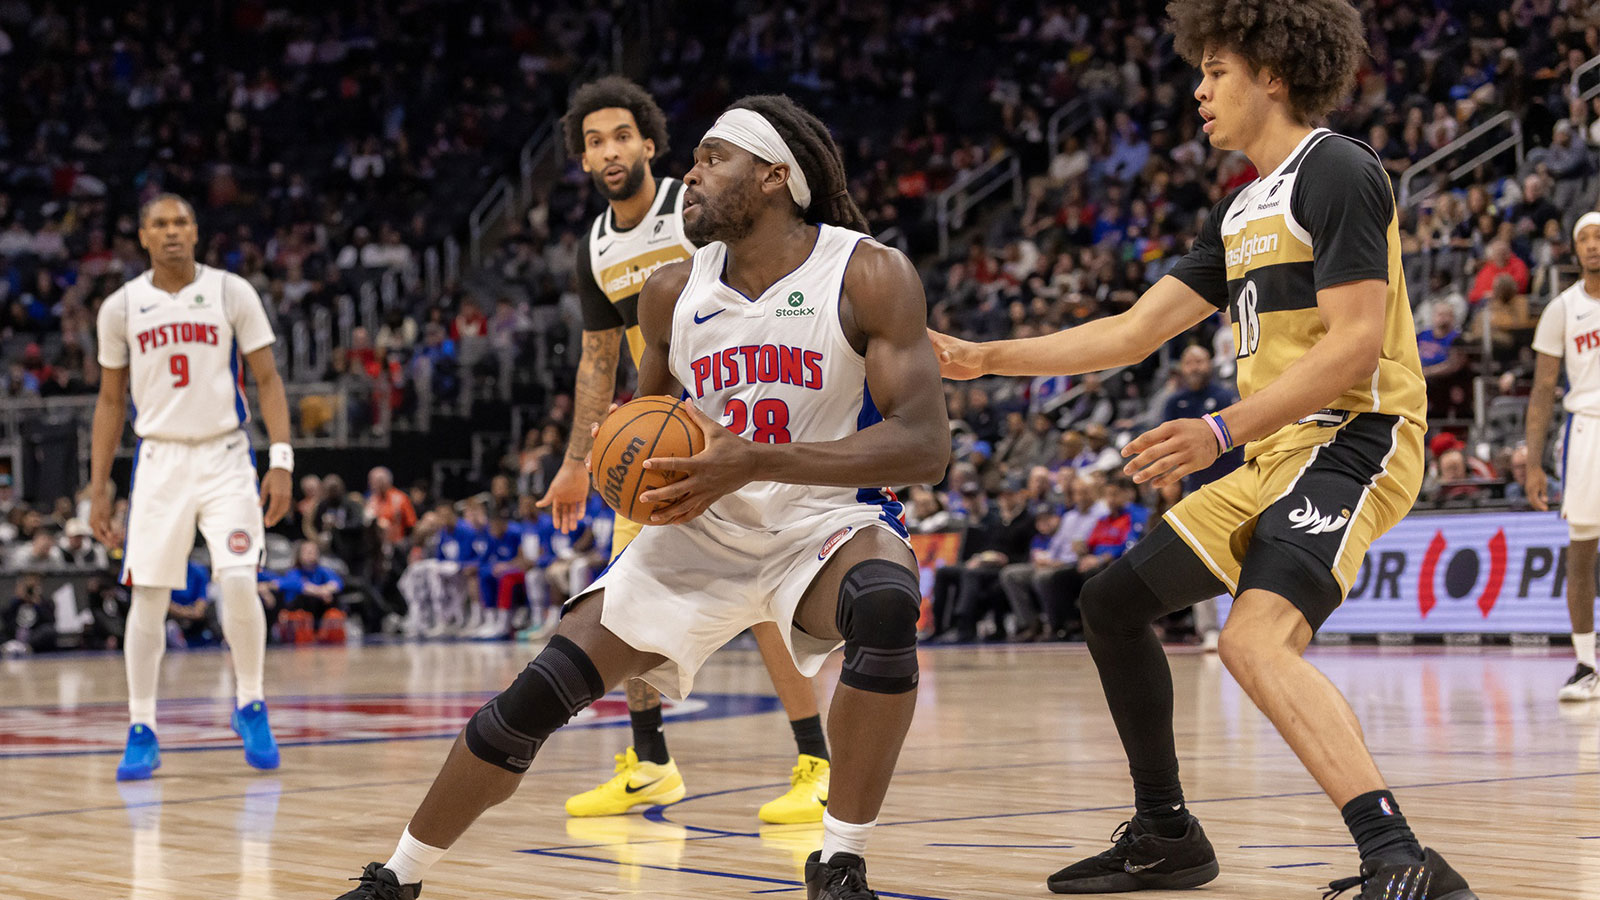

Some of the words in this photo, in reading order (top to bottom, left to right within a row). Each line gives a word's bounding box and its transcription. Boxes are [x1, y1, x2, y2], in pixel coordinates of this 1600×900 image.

[775, 307, 815, 317] StockX
[1236, 279, 1261, 359] 18
[137, 322, 219, 354] PISTONS
[169, 354, 190, 388] 9
[690, 344, 823, 399] PISTONS
[723, 398, 792, 444] 28
[603, 436, 648, 509] Wilson
